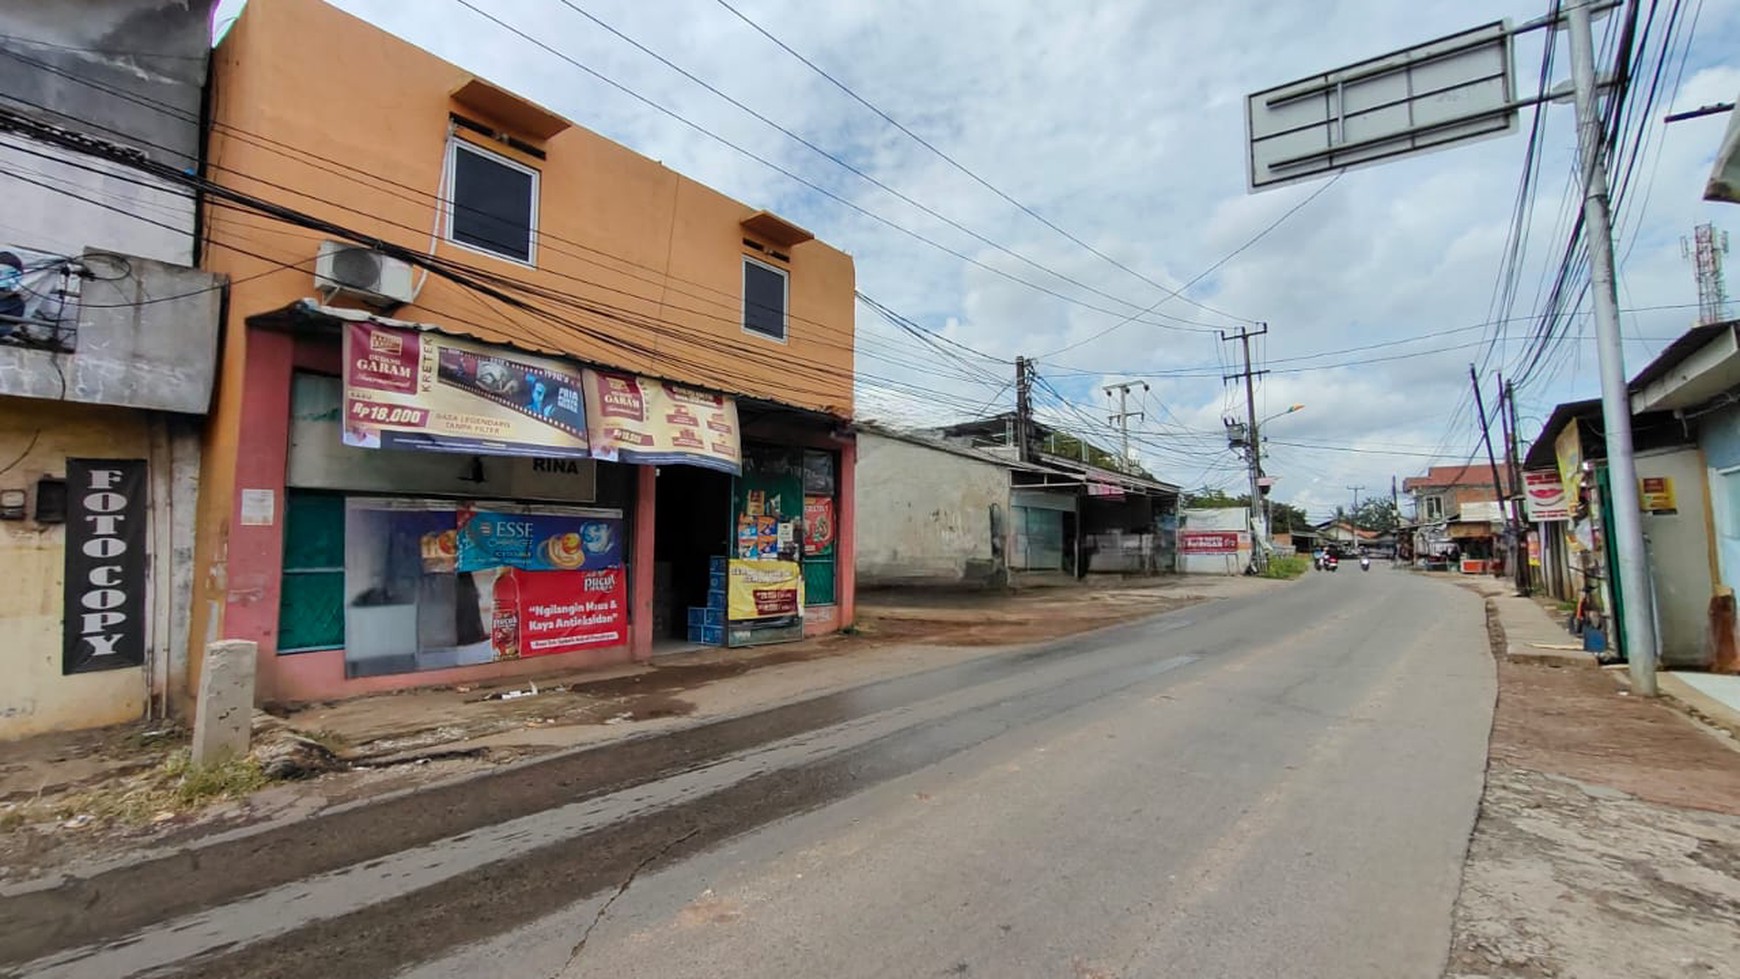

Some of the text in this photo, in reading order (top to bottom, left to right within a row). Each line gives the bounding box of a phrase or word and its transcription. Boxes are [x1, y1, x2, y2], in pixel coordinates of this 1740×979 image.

[356, 358, 411, 378] GARAM
[421, 337, 434, 392] KRETEK
[532, 457, 579, 475] RINA
[496, 521, 534, 538] ESSE
[529, 619, 554, 632] Kaya
